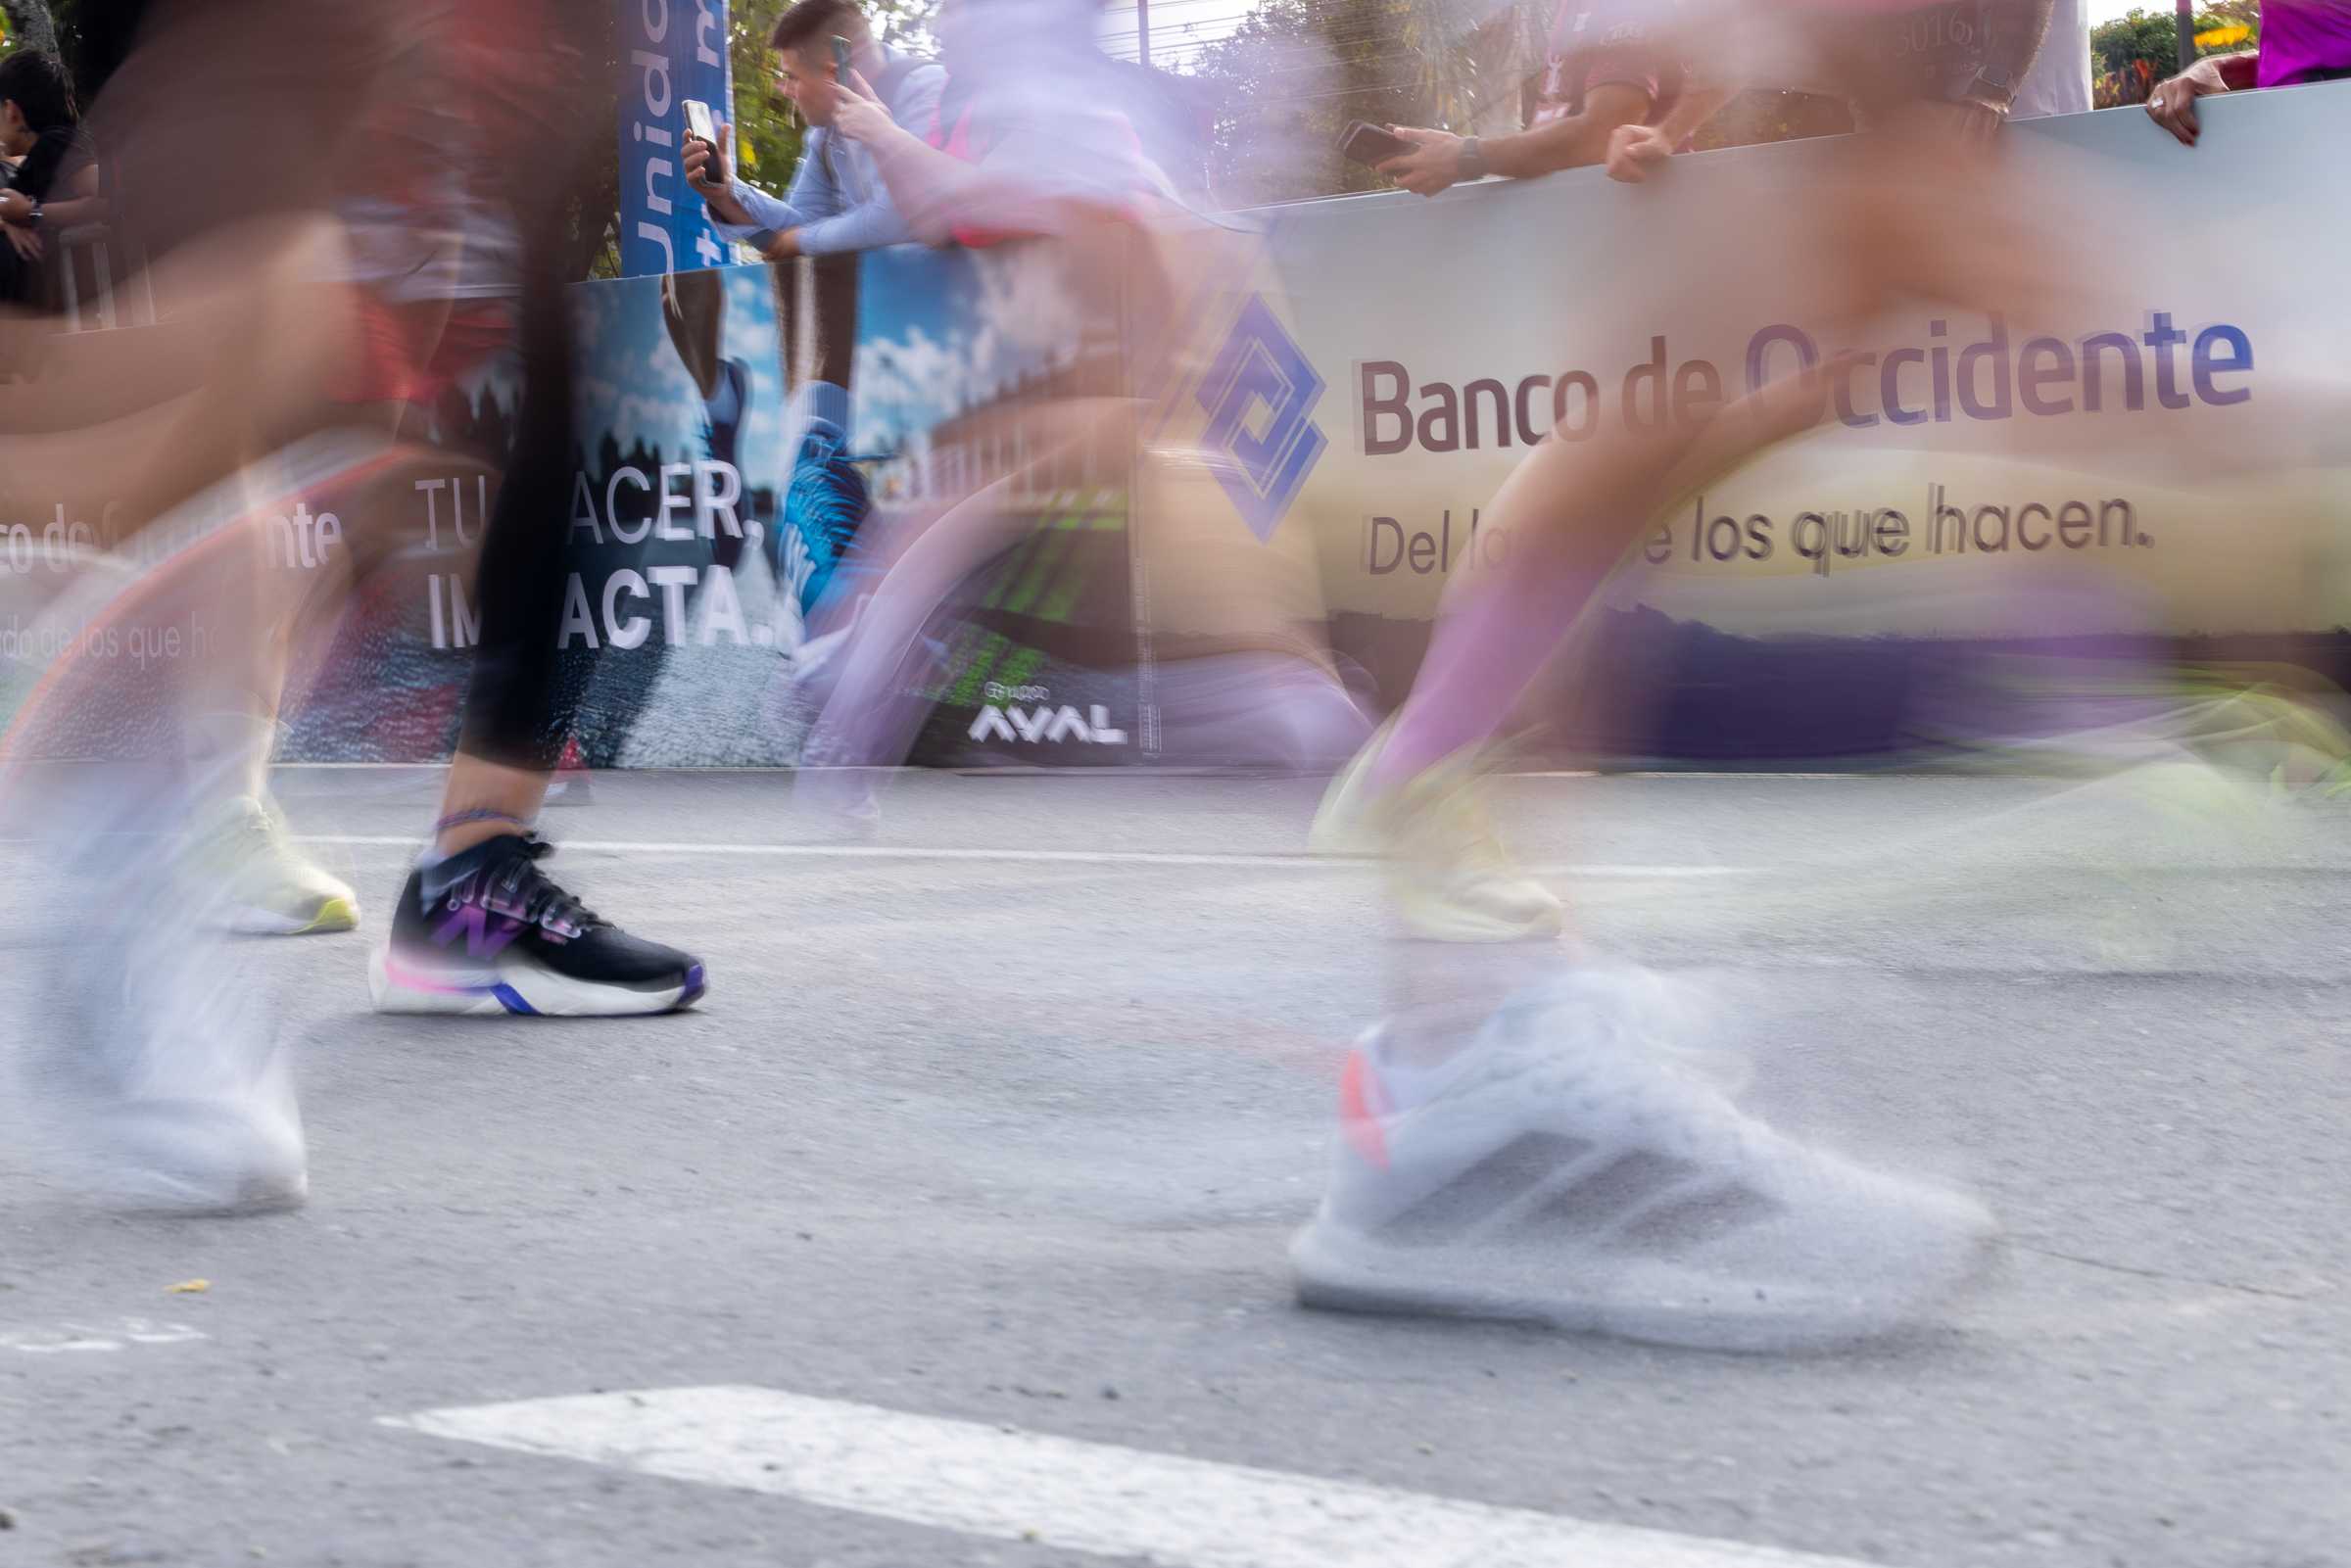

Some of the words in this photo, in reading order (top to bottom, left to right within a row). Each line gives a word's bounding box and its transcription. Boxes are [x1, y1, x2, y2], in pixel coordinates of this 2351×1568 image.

[1360, 358, 1600, 456] Banco
[1621, 335, 1723, 444] de
[1745, 311, 2254, 430] Occidente
[414, 475, 487, 550] TU
[568, 458, 765, 548] ACER,
[1368, 508, 1450, 576] Del
[1690, 495, 1773, 562] los
[1790, 504, 1911, 579] que
[1928, 482, 2155, 554] hacen.
[128, 625, 182, 671] que
